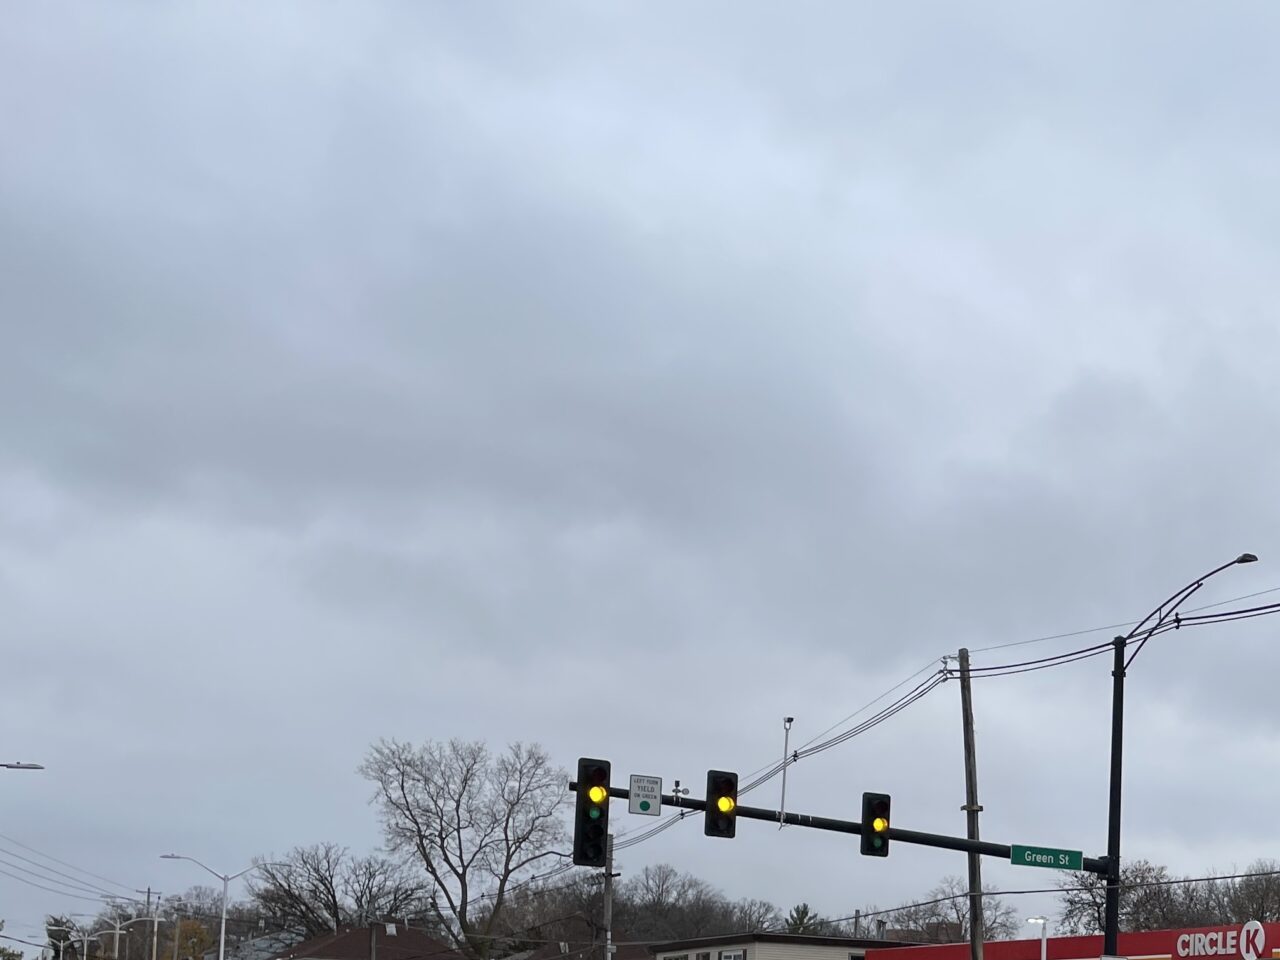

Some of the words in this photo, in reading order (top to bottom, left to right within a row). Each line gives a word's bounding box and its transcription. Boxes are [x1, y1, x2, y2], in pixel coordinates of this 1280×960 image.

[637, 785, 655, 793] YIELD
[1024, 850, 1054, 864] Green
[1059, 854, 1070, 866] St
[1176, 930, 1238, 957] CIRCLE
[1243, 924, 1263, 960] K
